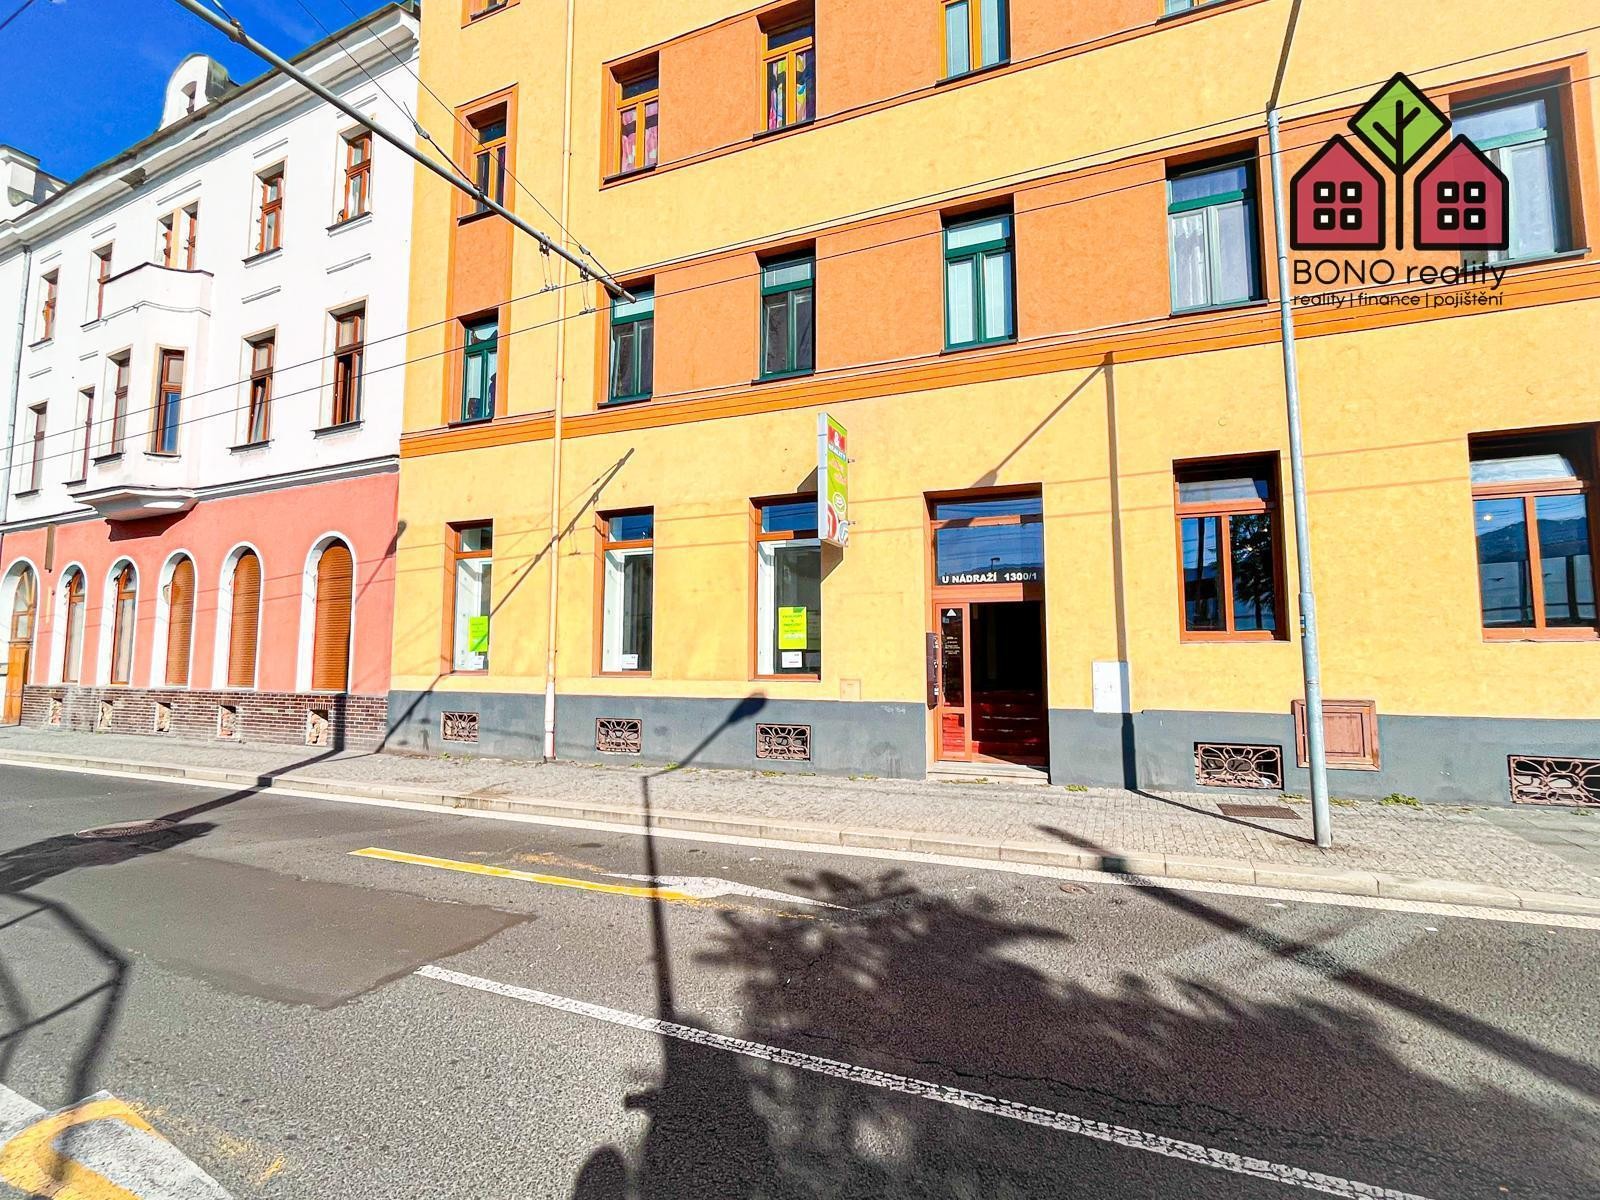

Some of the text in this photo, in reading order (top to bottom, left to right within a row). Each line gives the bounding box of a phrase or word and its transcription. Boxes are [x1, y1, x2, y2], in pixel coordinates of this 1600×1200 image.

[941, 571, 1037, 584] U NÁDRAŽÍ 1300/1
